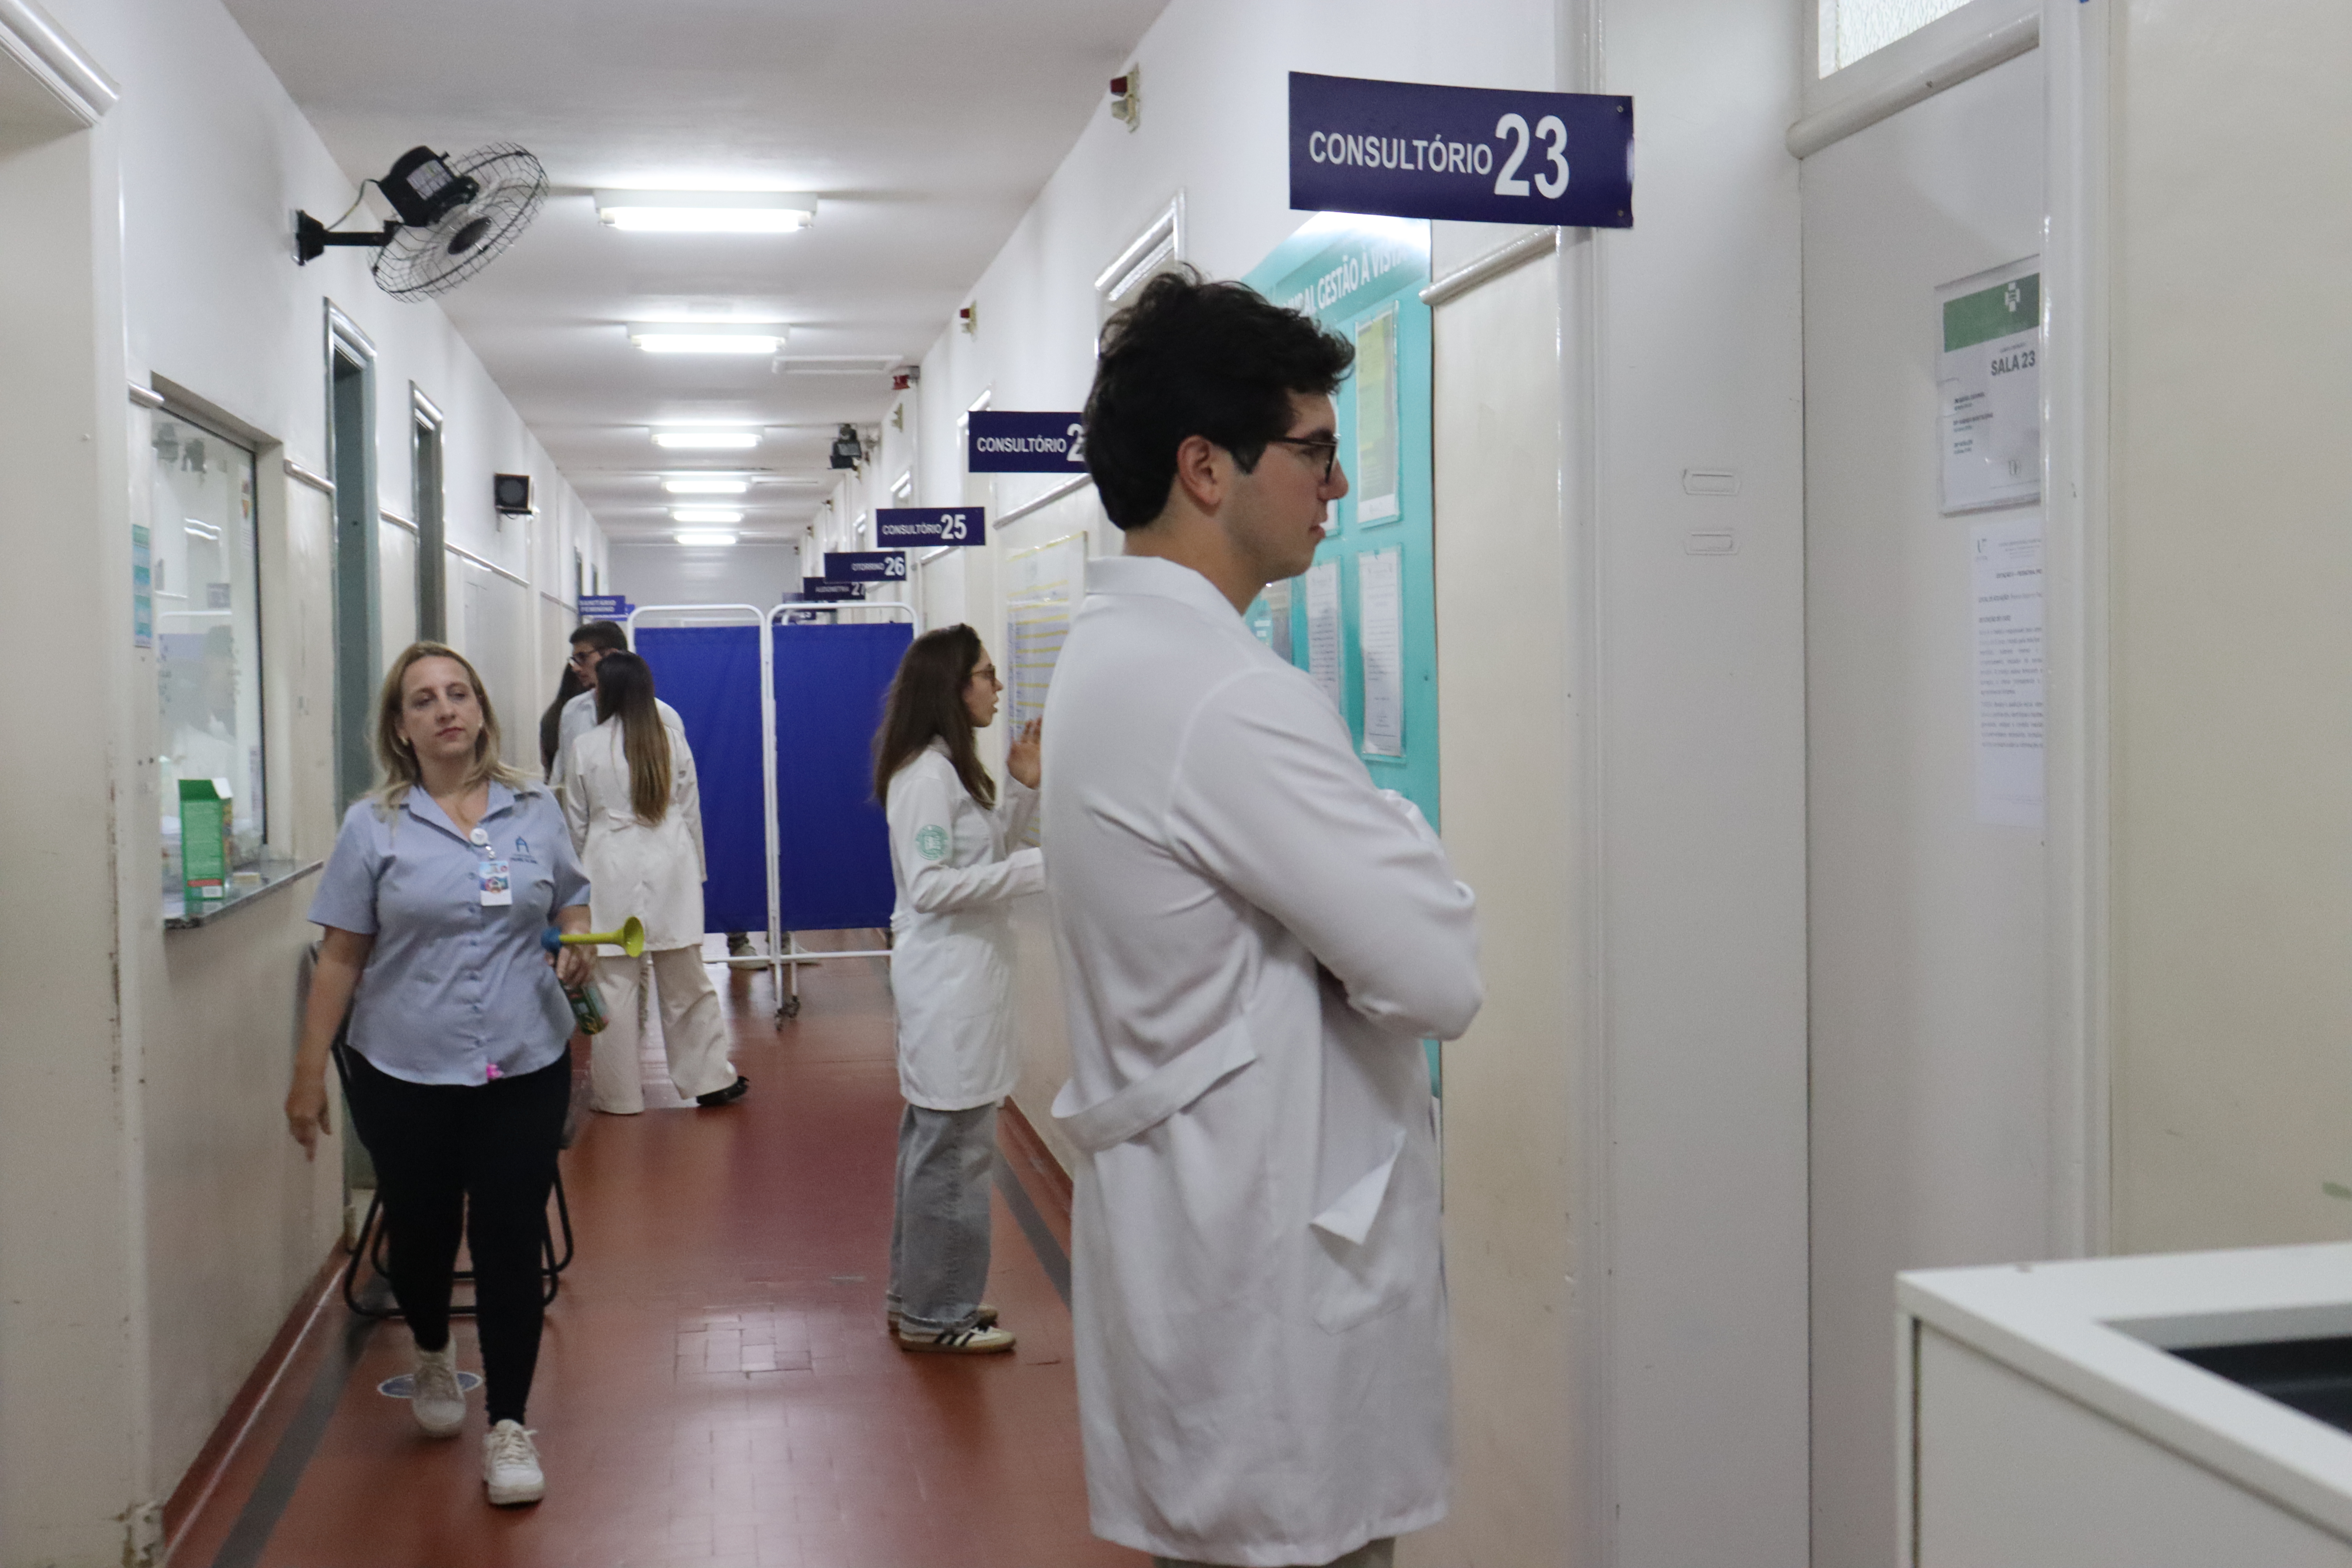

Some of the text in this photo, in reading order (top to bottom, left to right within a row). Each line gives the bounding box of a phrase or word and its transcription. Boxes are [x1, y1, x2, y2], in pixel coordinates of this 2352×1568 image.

[1309, 113, 1570, 199] CONSULTÓRIO 23
[1318, 255, 1359, 309] GESTÃO
[1991, 350, 2035, 376] SALA 23
[976, 423, 1085, 462] CONSULTÓRIO 2
[882, 514, 967, 540] CONSULTÓRIO 25
[884, 556, 905, 576] 26
